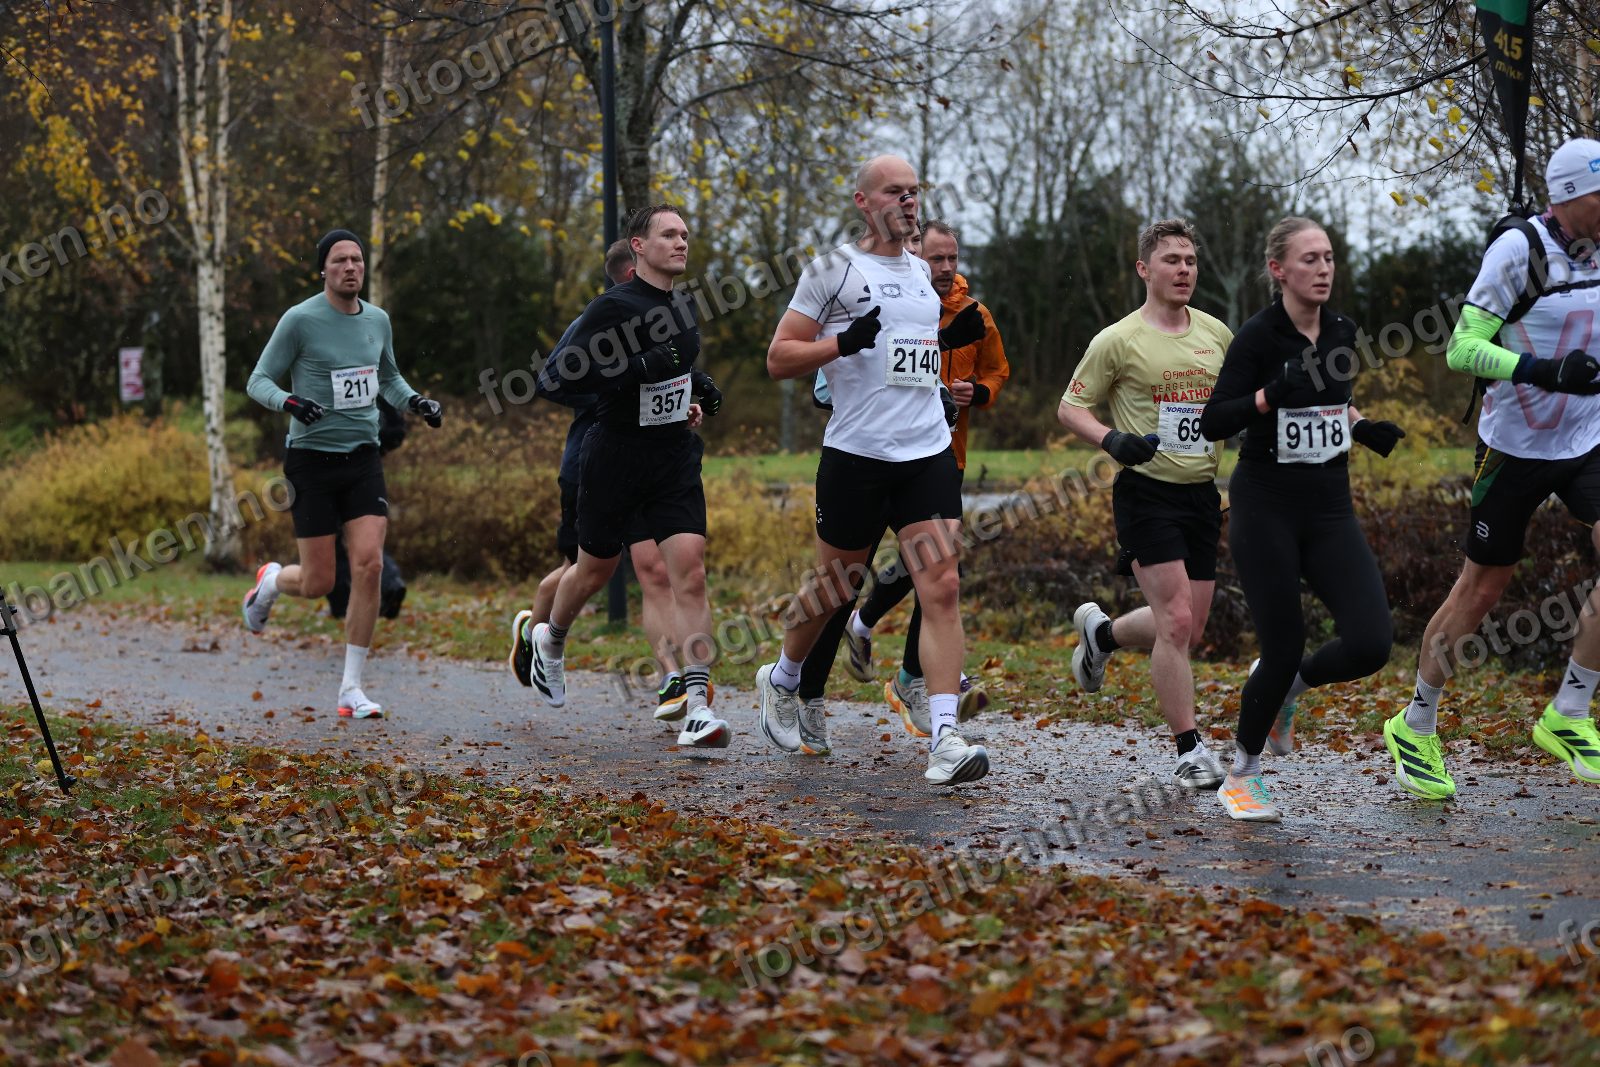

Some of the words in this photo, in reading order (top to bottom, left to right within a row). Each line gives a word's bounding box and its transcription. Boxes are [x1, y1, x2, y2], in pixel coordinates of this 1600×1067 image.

[893, 347, 939, 375] 2140
[344, 378, 368, 398] 211
[1150, 380, 1193, 393] BERGEN
[651, 388, 685, 415] 357
[1285, 419, 1344, 450] 9118
